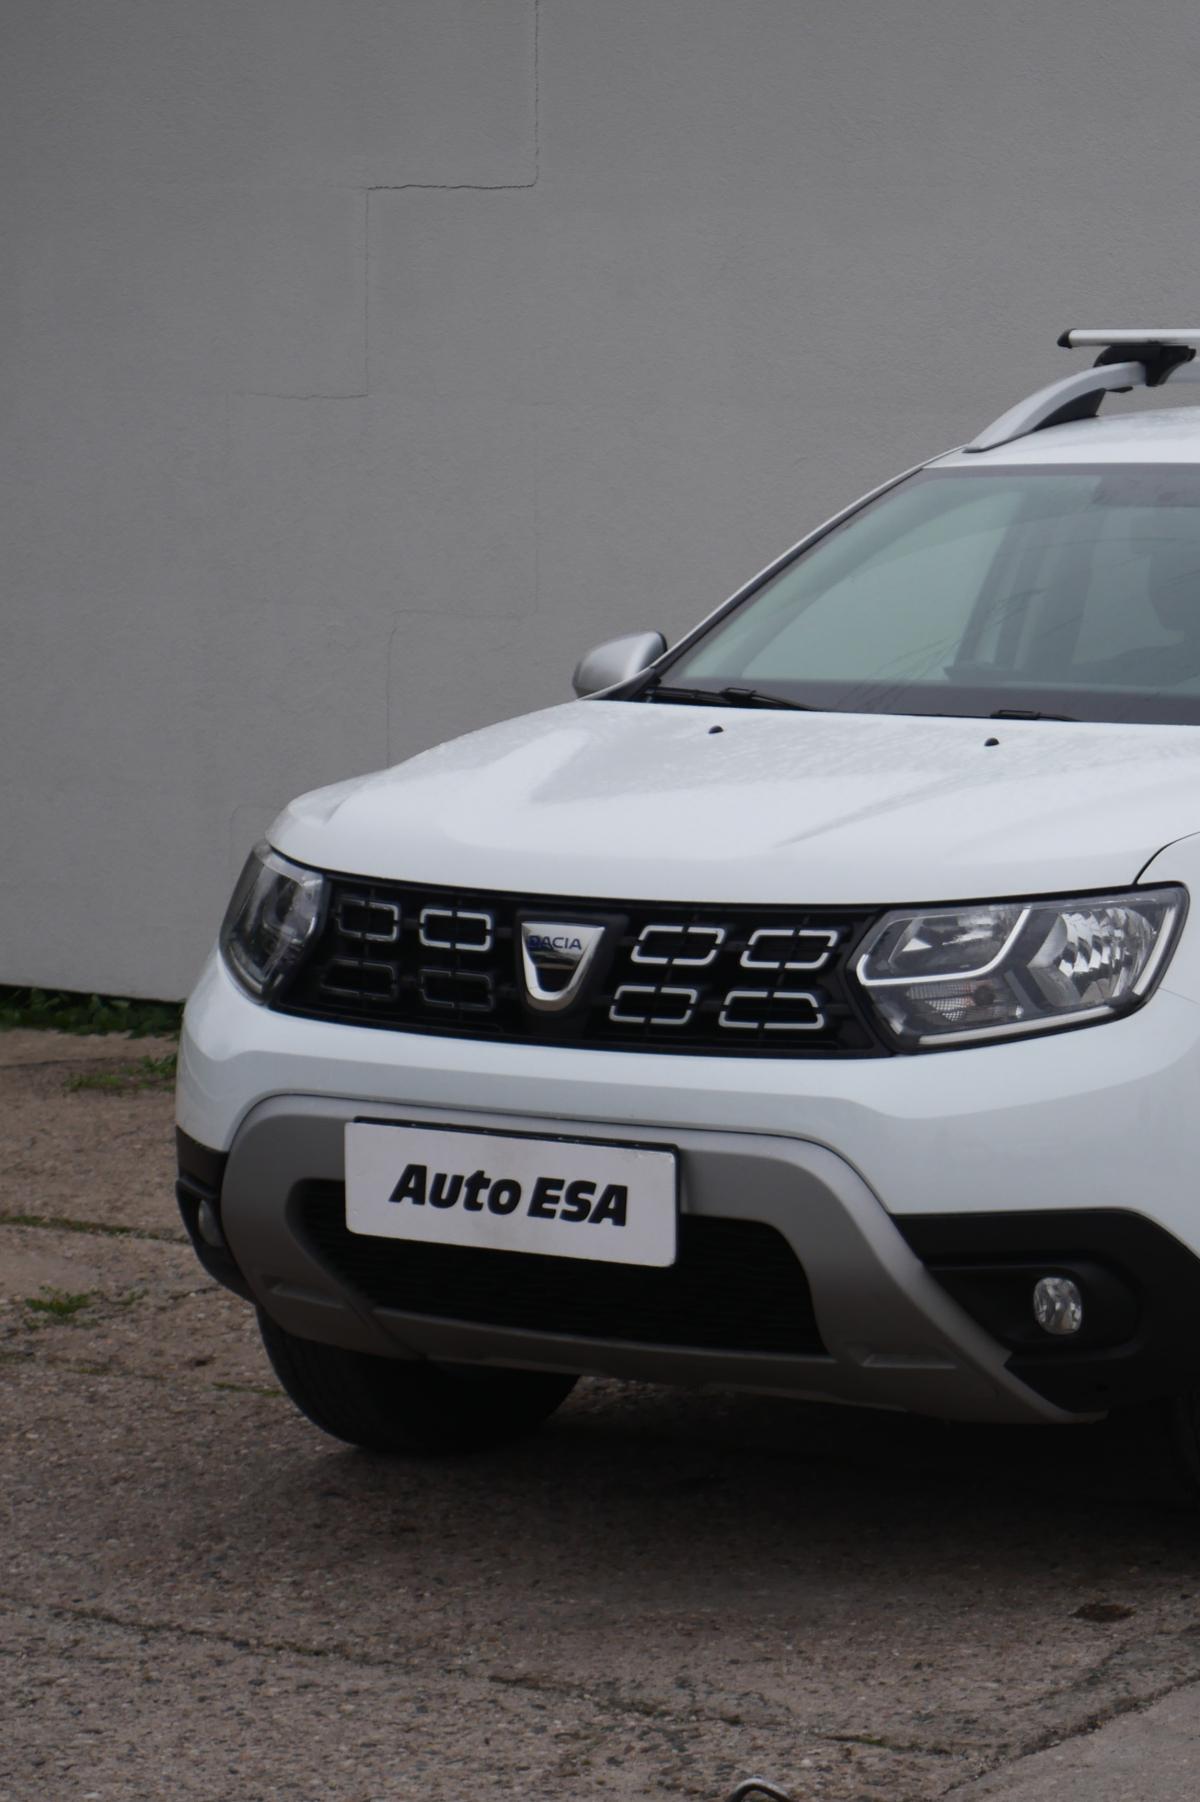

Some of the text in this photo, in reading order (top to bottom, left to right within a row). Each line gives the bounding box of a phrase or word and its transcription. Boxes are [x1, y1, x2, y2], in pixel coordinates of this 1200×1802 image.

[527, 935, 582, 949] DACIA
[389, 1163, 629, 1227] Auto ESA
